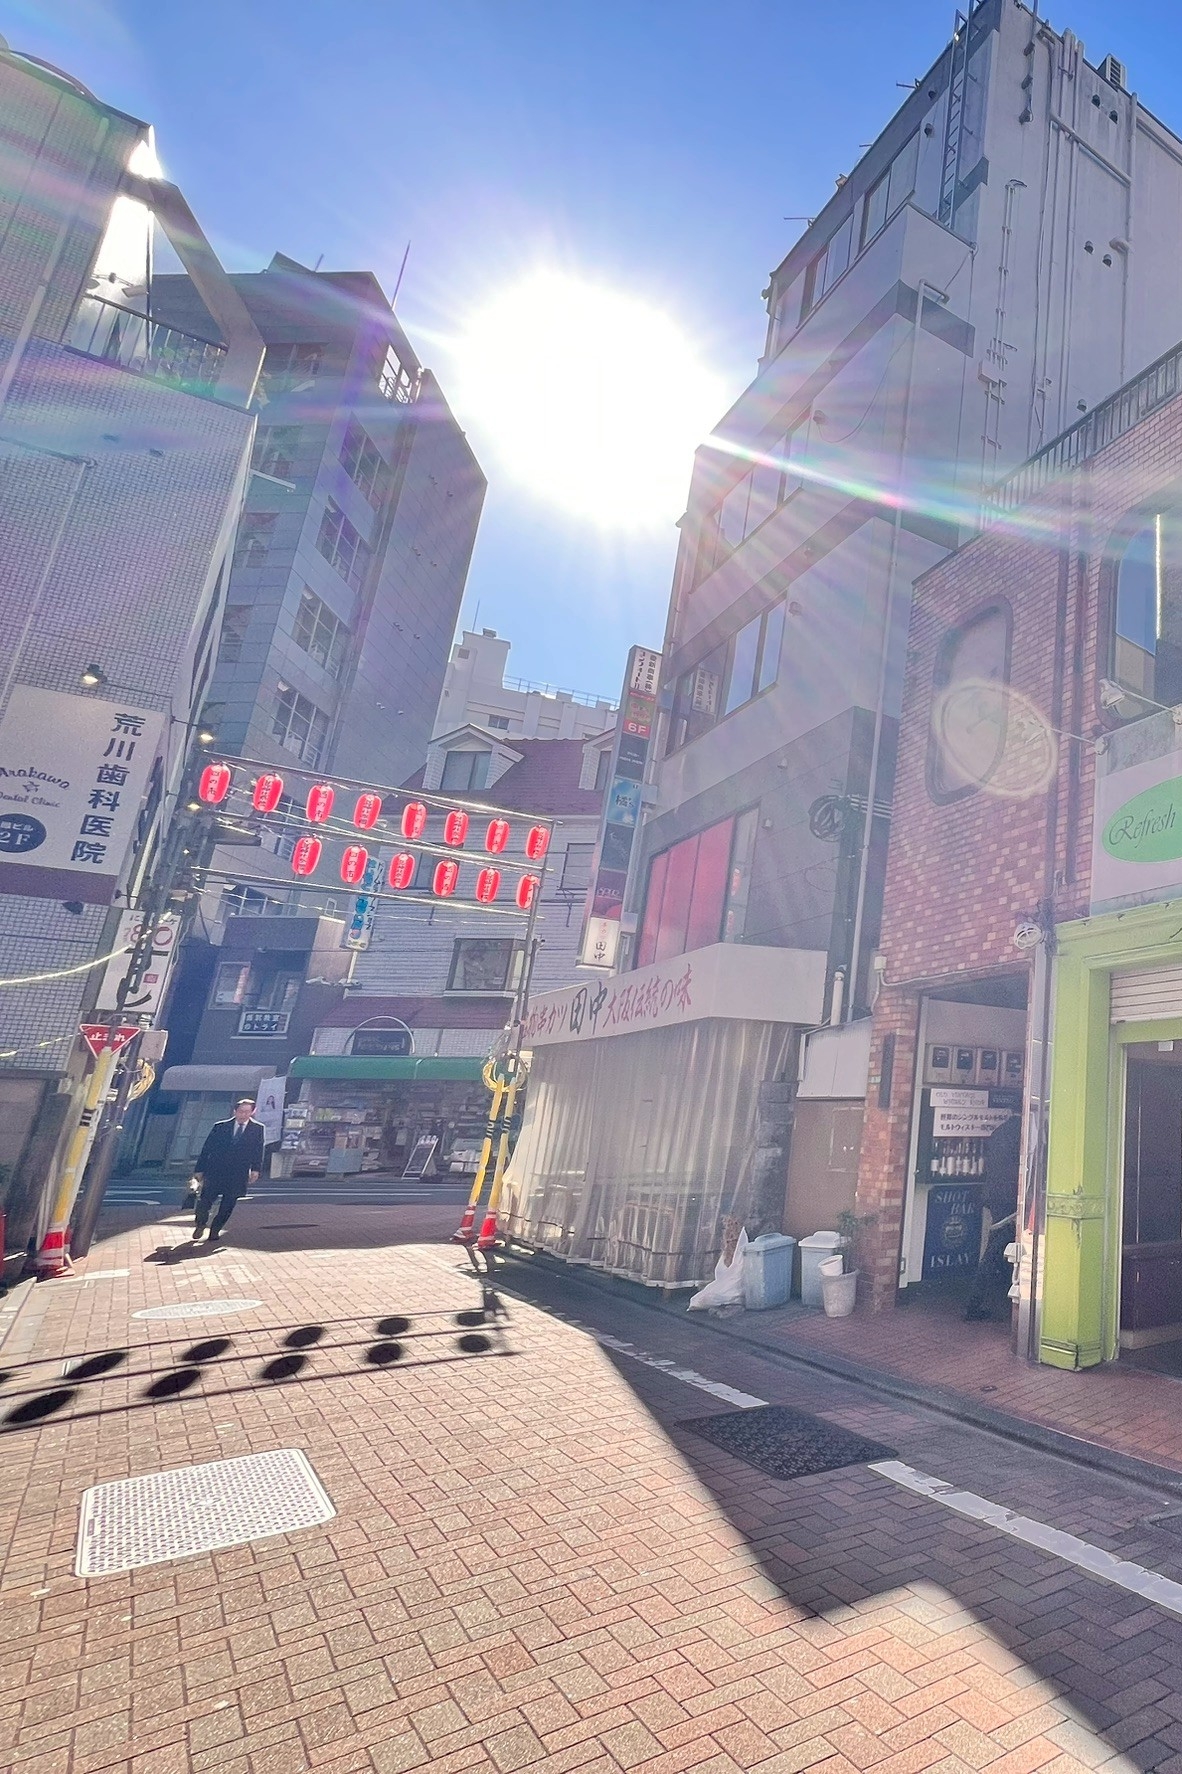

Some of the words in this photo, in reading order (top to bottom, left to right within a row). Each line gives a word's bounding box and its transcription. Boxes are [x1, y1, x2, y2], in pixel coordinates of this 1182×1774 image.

[628, 722, 647, 734] 6F
[70, 712, 146, 865] 荒川歯科医院
[1109, 803, 1176, 849] Refresh
[570, 981, 608, 1035] 田中
